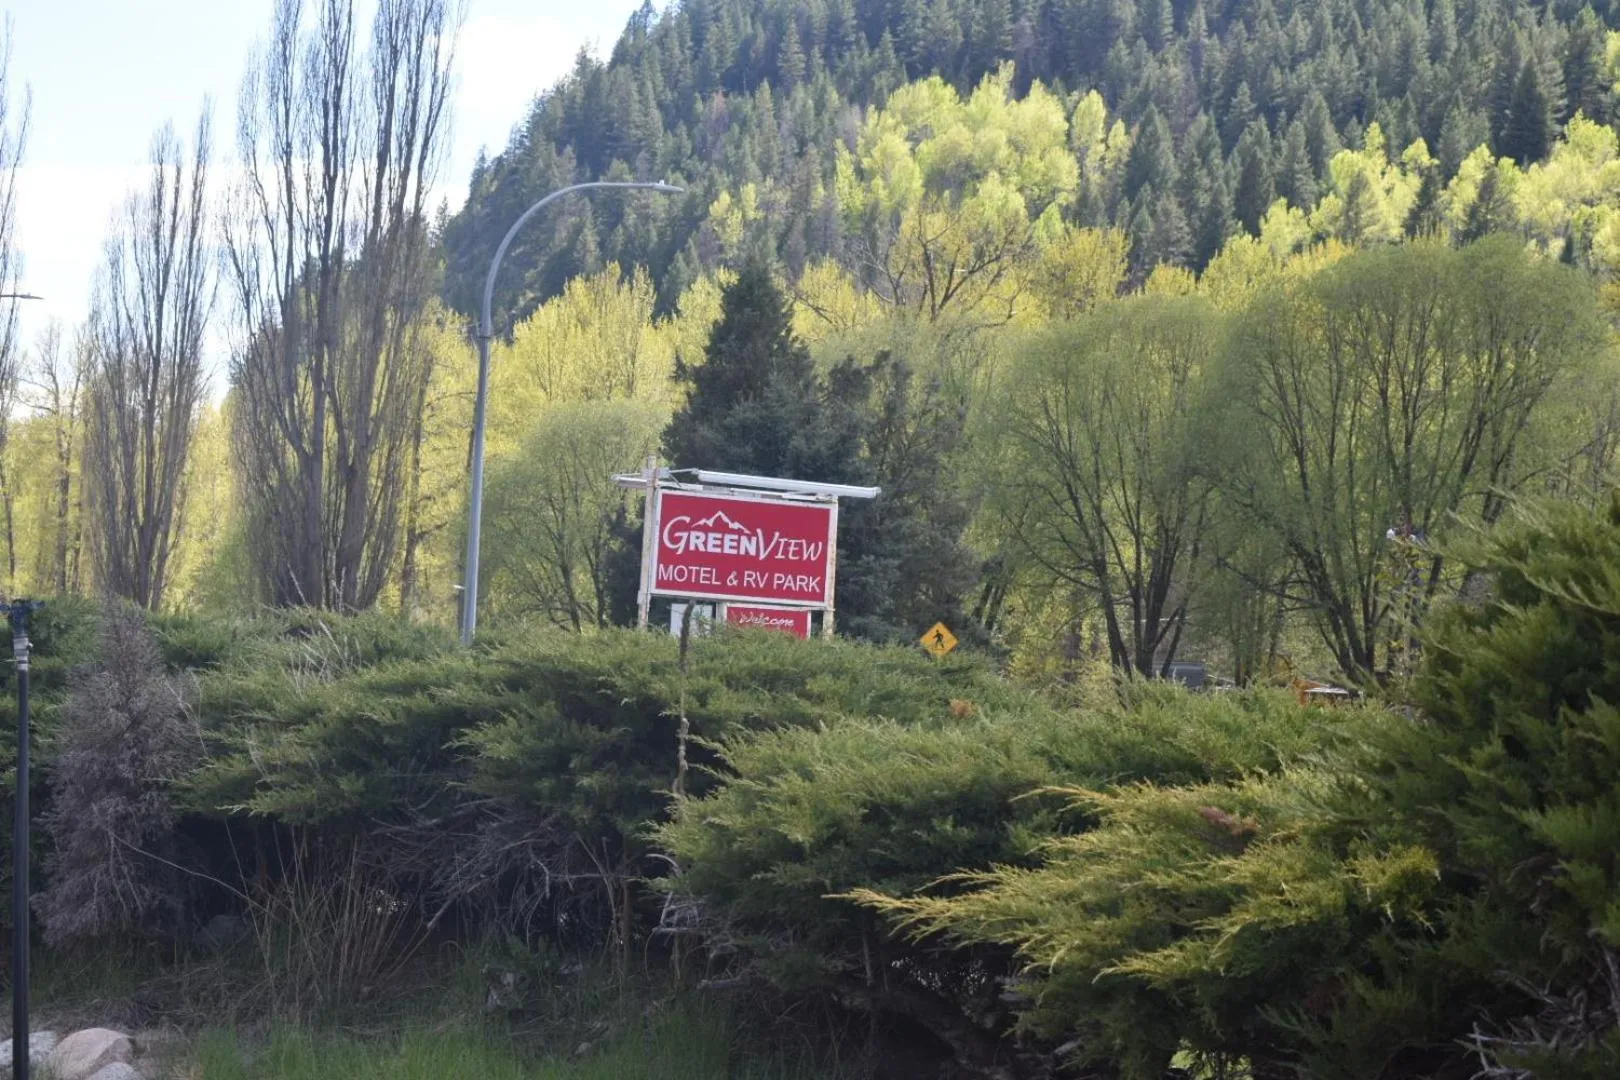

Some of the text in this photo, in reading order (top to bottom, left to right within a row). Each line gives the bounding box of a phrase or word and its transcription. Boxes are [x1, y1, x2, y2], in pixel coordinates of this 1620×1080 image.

[658, 563, 821, 593] MOTEL & RV PARK
